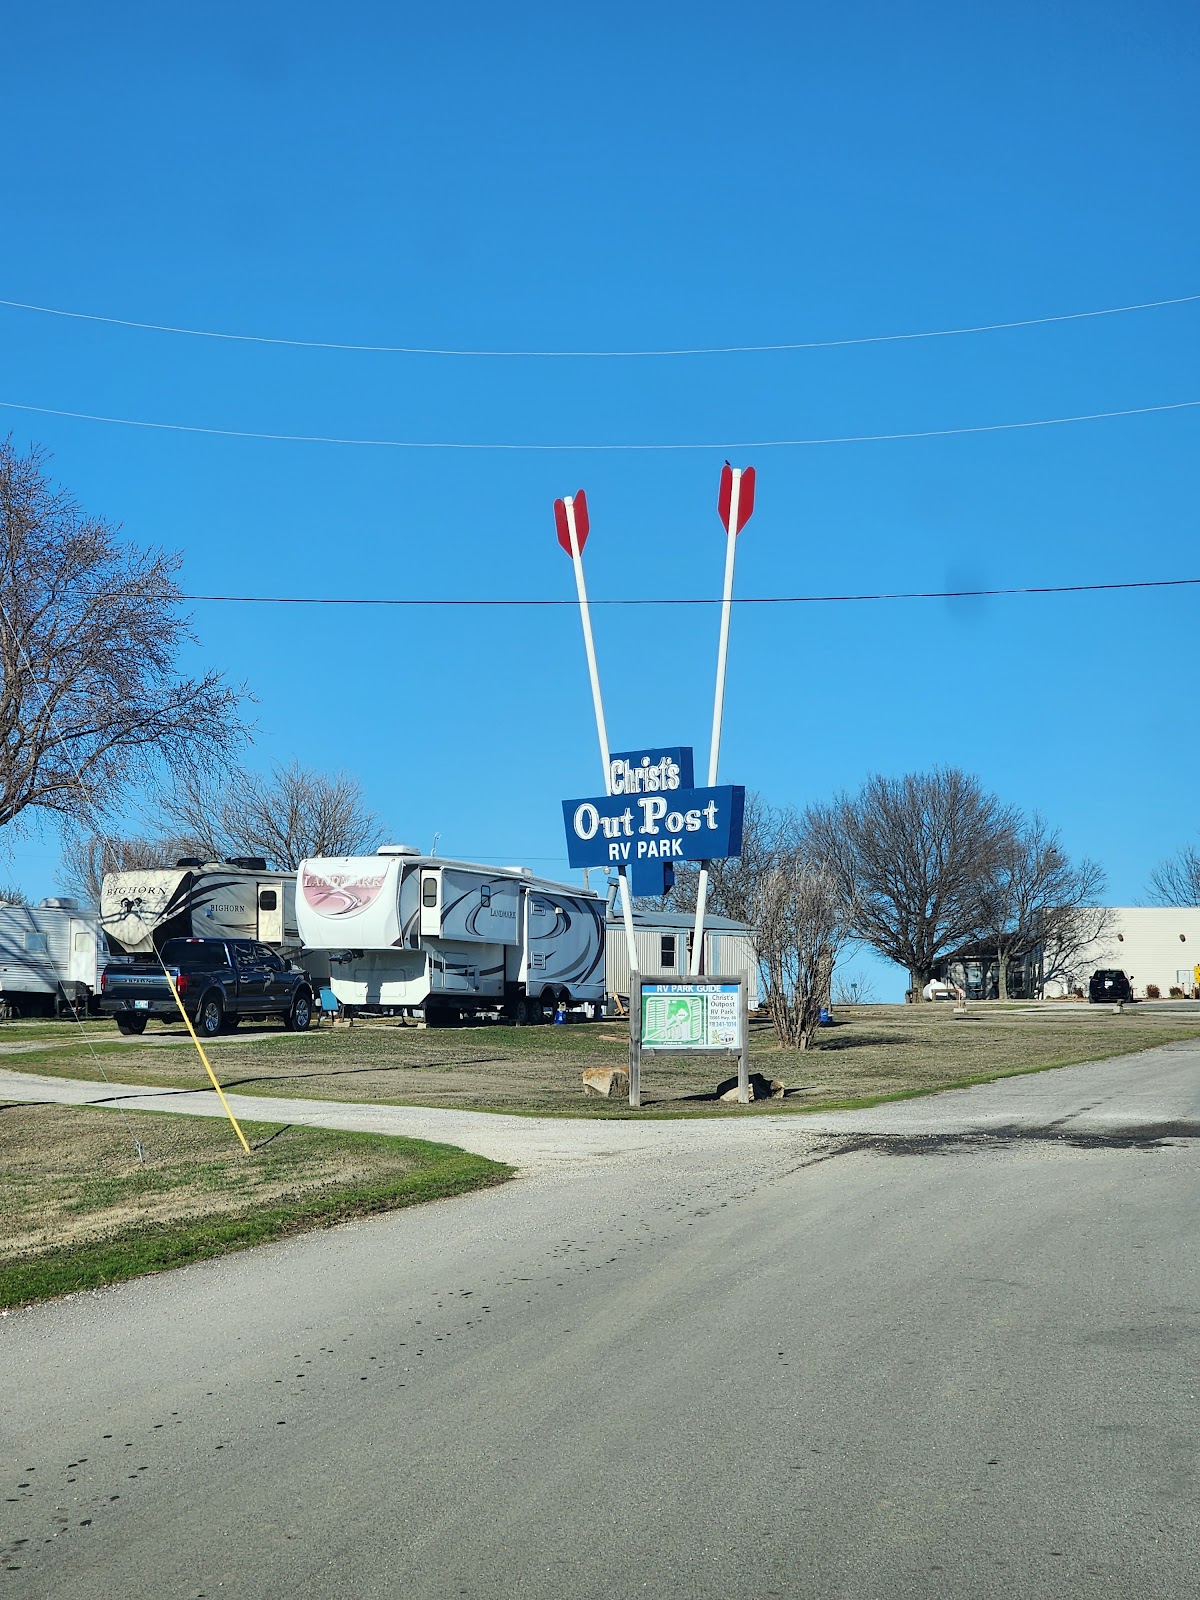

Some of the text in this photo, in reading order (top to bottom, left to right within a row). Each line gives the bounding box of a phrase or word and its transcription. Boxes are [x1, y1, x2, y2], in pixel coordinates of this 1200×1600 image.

[609, 756, 680, 796] Christ's
[608, 838, 684, 861] RV PARK
[106, 886, 168, 896] BIGHORN
[210, 904, 245, 913] BIGHORN
[656, 985, 722, 993] RV PARK GUIDE
